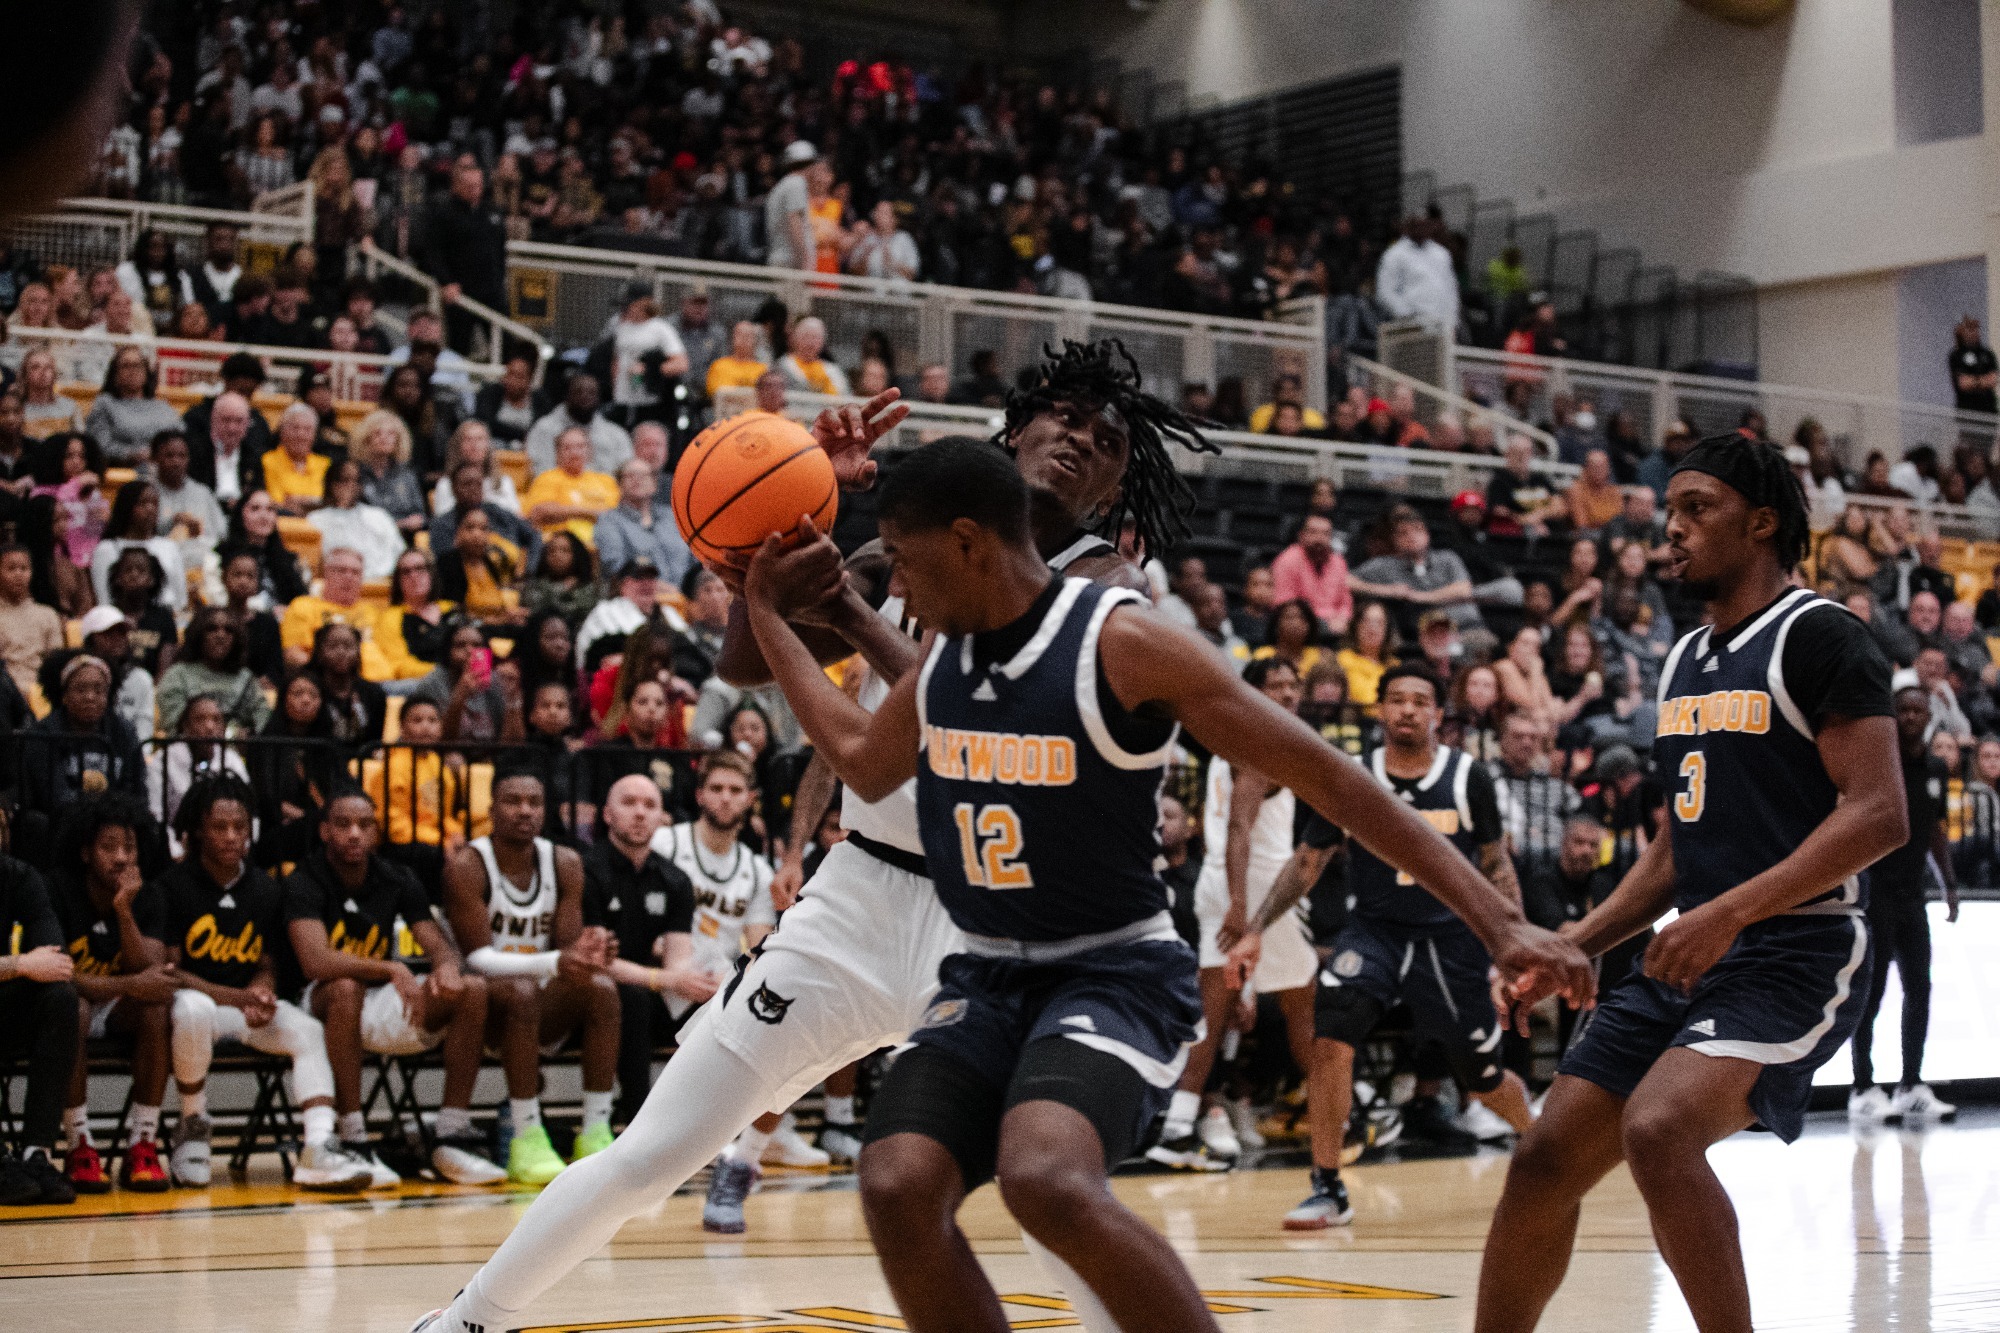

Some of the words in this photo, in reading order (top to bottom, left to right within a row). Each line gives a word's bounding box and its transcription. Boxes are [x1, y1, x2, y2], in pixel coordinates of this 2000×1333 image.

[1674, 751, 1706, 822] 3
[954, 803, 1034, 889] 12
[185, 914, 263, 962] Owls
